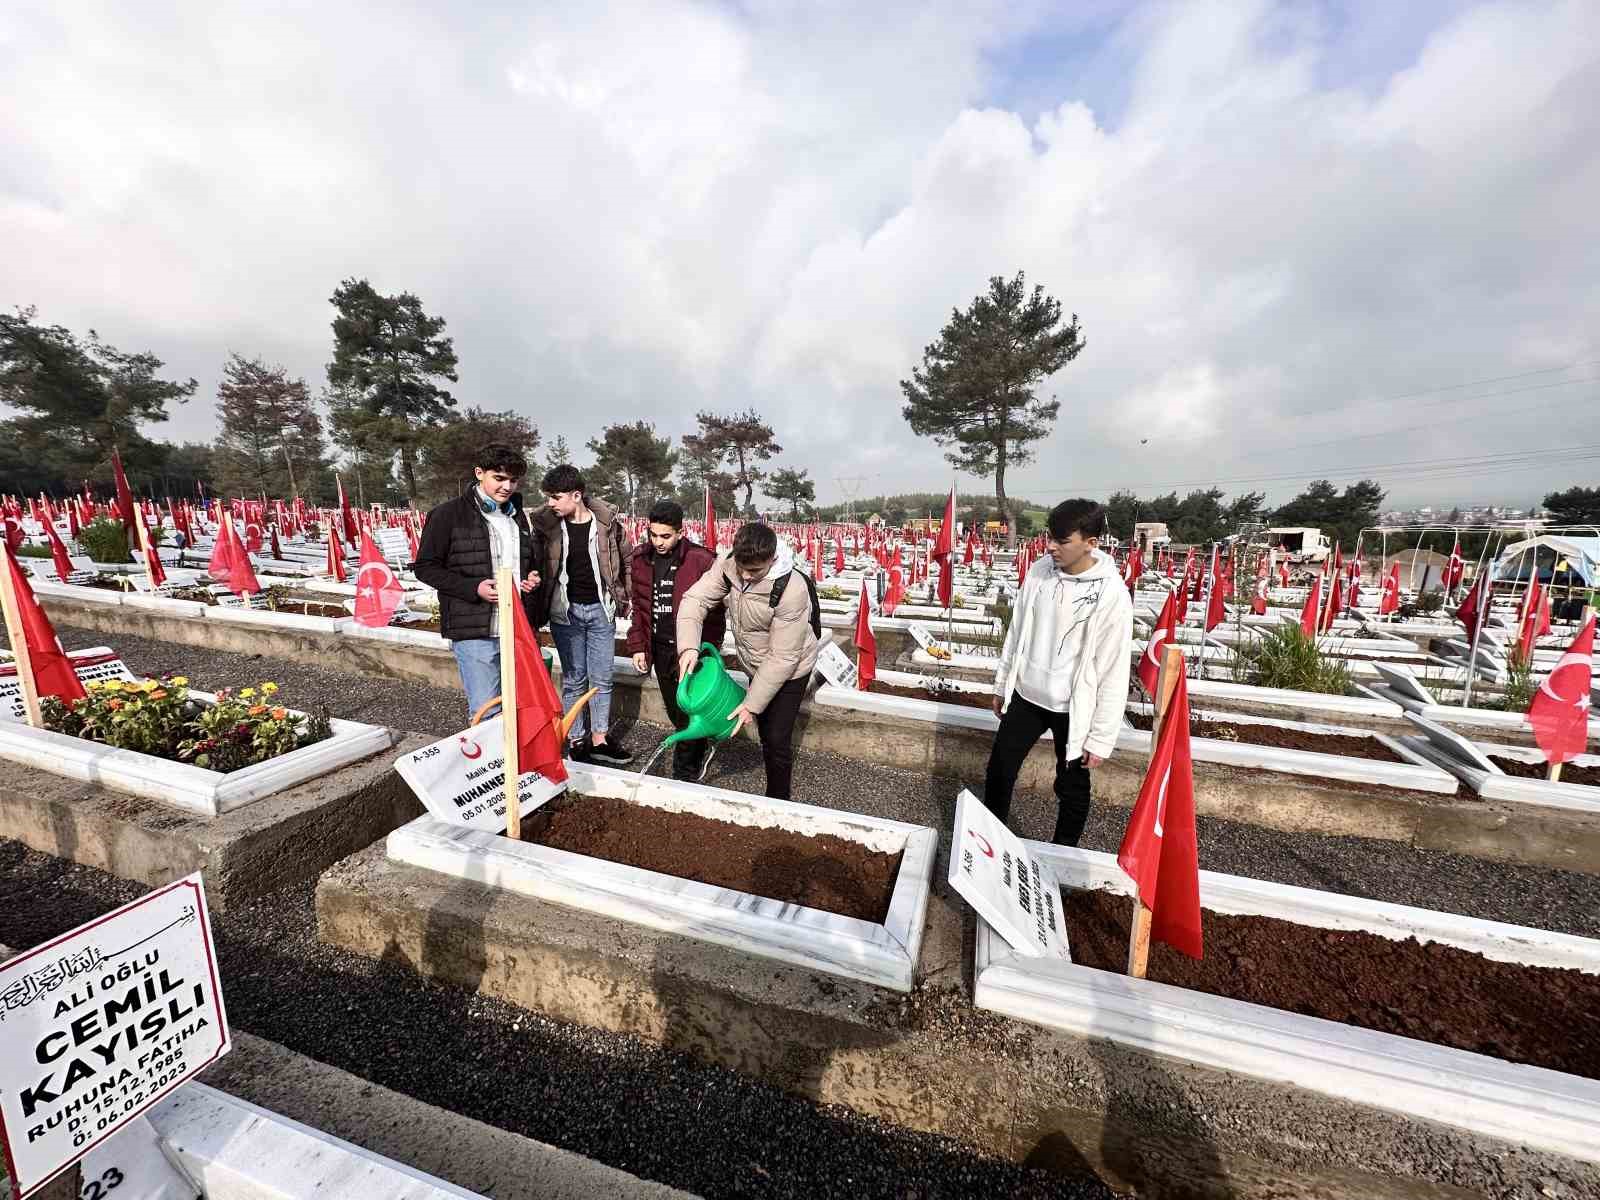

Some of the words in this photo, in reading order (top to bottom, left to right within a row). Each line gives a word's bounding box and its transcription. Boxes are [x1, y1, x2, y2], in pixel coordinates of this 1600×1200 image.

[413, 746, 441, 764] A-355
[1018, 883, 1031, 914] ENES
[35, 969, 185, 1065] CEMİL
[53, 981, 94, 1018] ALİ
[101, 949, 159, 991] OĞLU
[20, 983, 205, 1118] KAYIŞLI
[27, 1068, 133, 1144] RUHUNA
[137, 1017, 209, 1070] FATİHA
[68, 1115, 88, 1133] D:
[92, 1047, 184, 1114] 15.12.1985
[73, 1130, 93, 1147] Ö:
[97, 1061, 187, 1131] 06.02.2023
